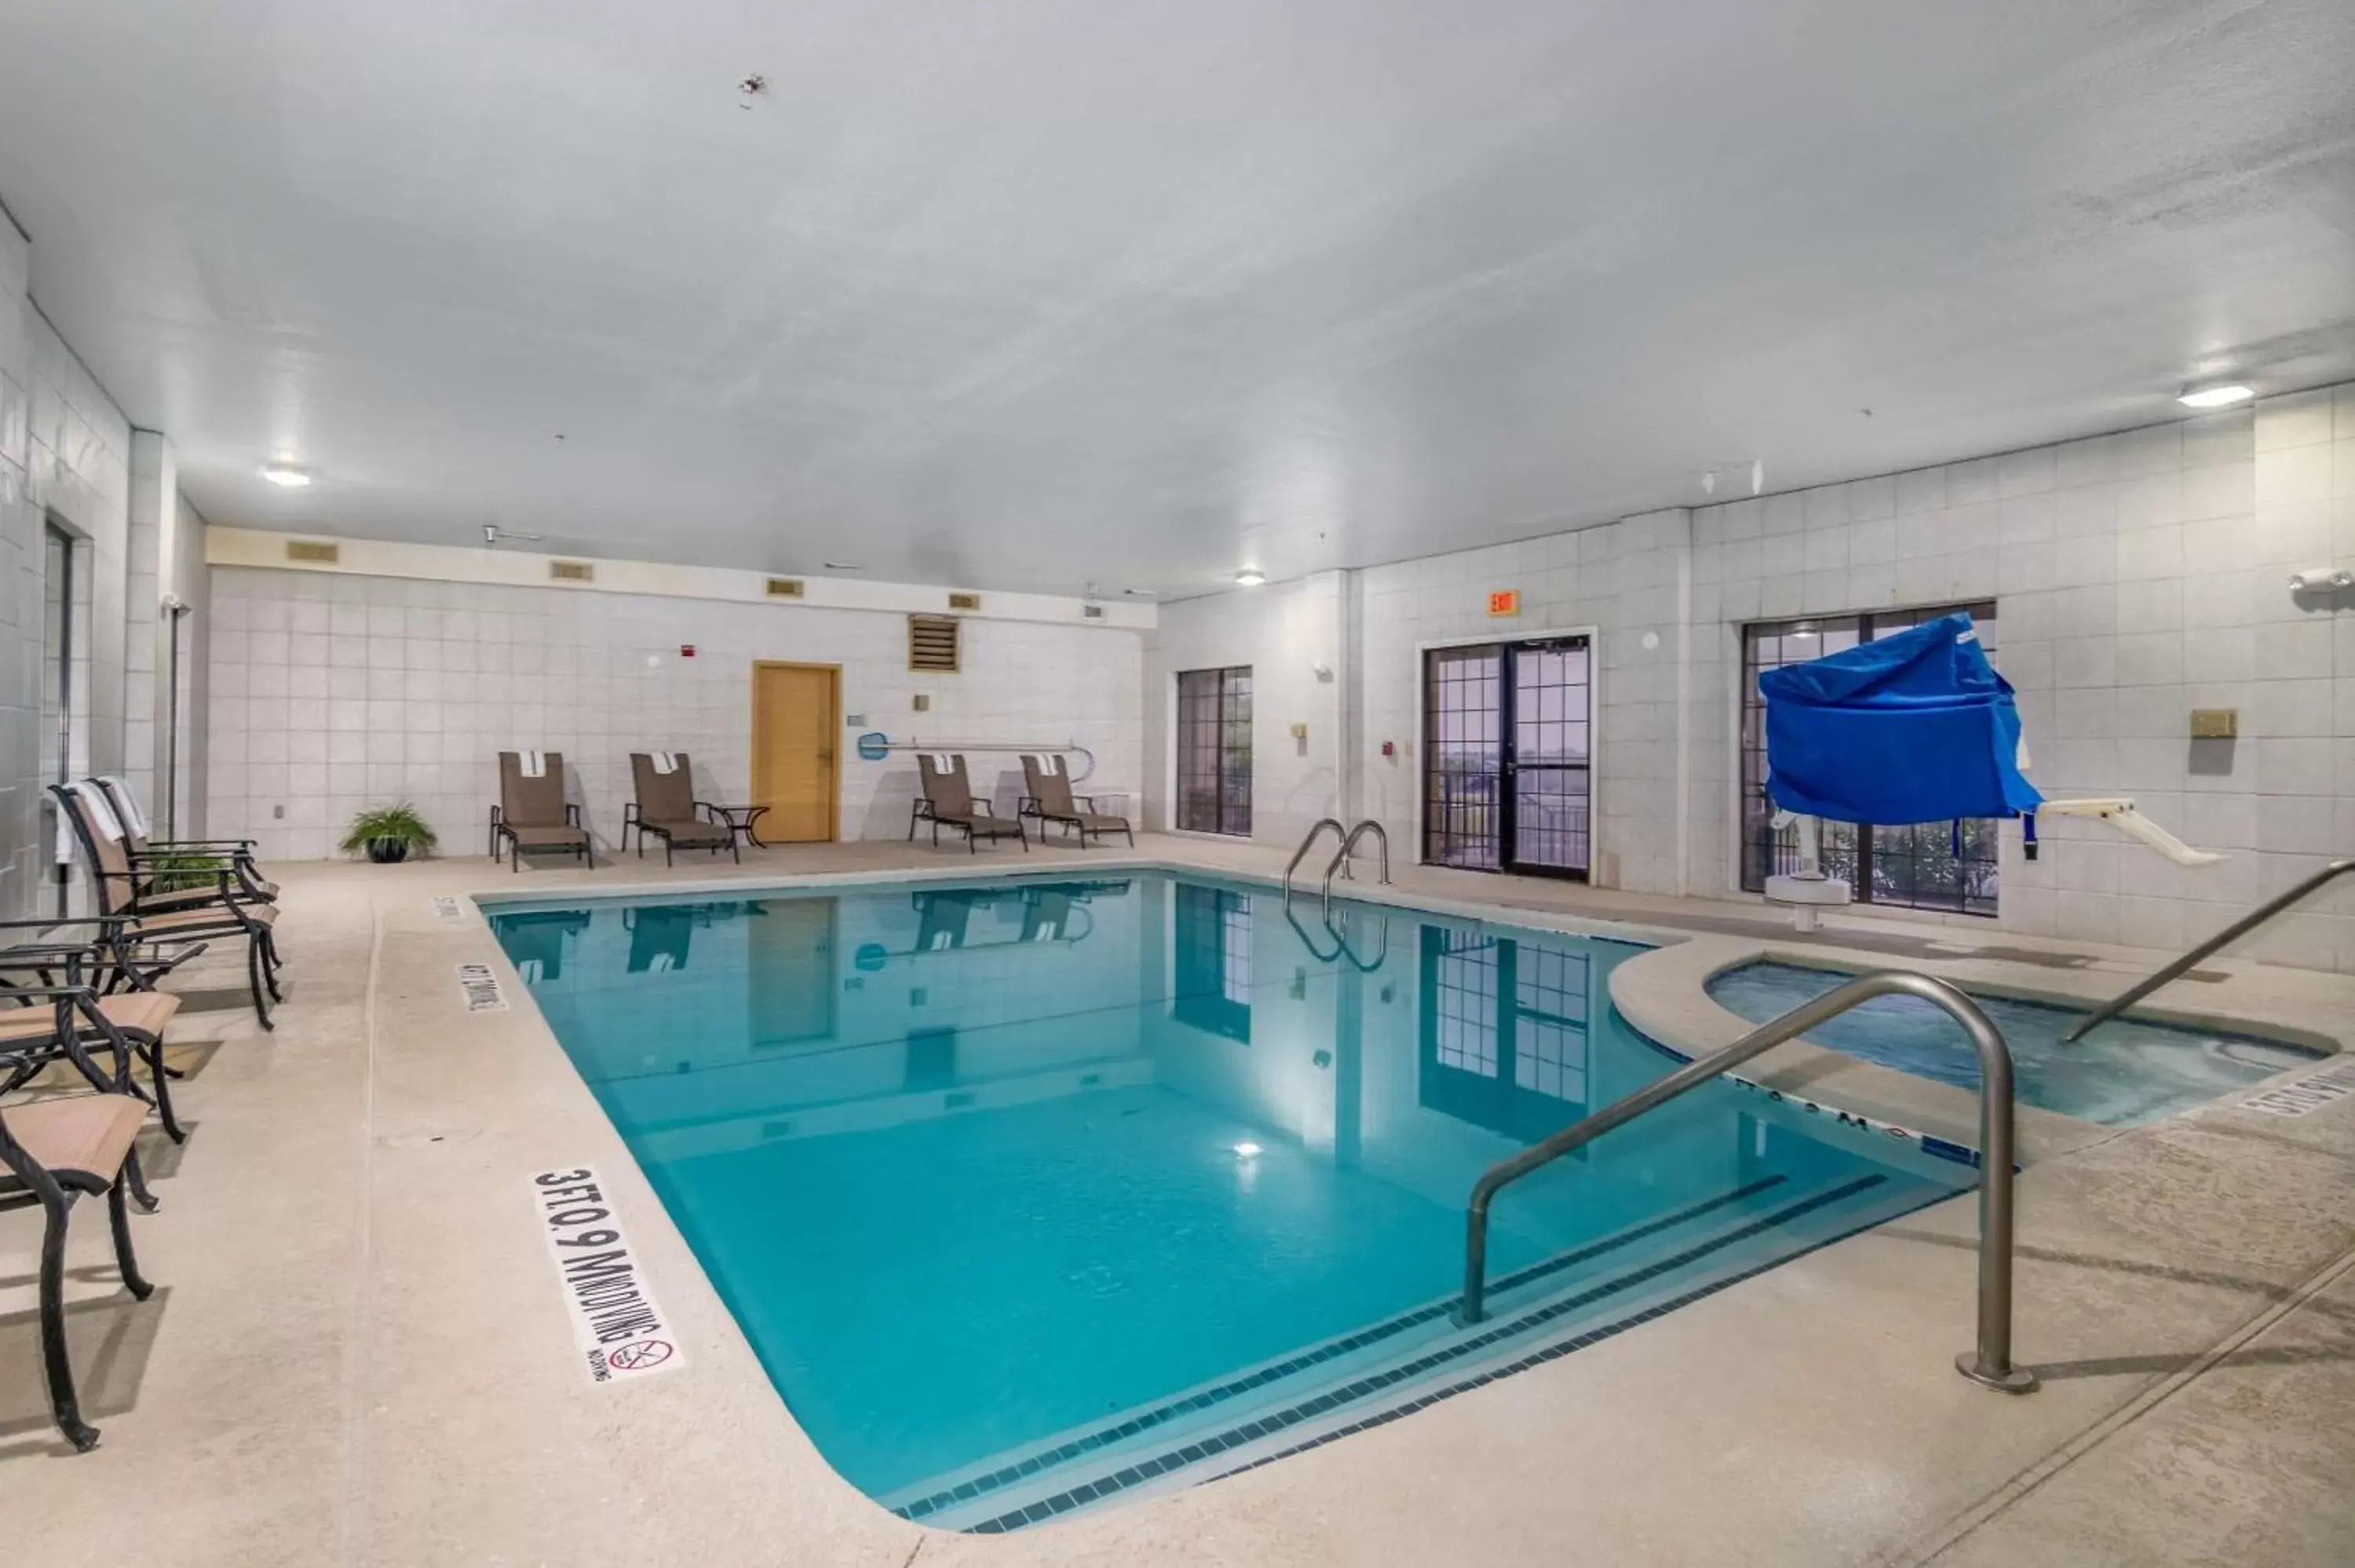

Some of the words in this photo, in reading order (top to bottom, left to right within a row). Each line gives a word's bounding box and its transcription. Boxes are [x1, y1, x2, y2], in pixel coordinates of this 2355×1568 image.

[535, 1169, 592, 1186] 3
[562, 1249, 634, 1283] M
[579, 1289, 662, 1344] DIVING
